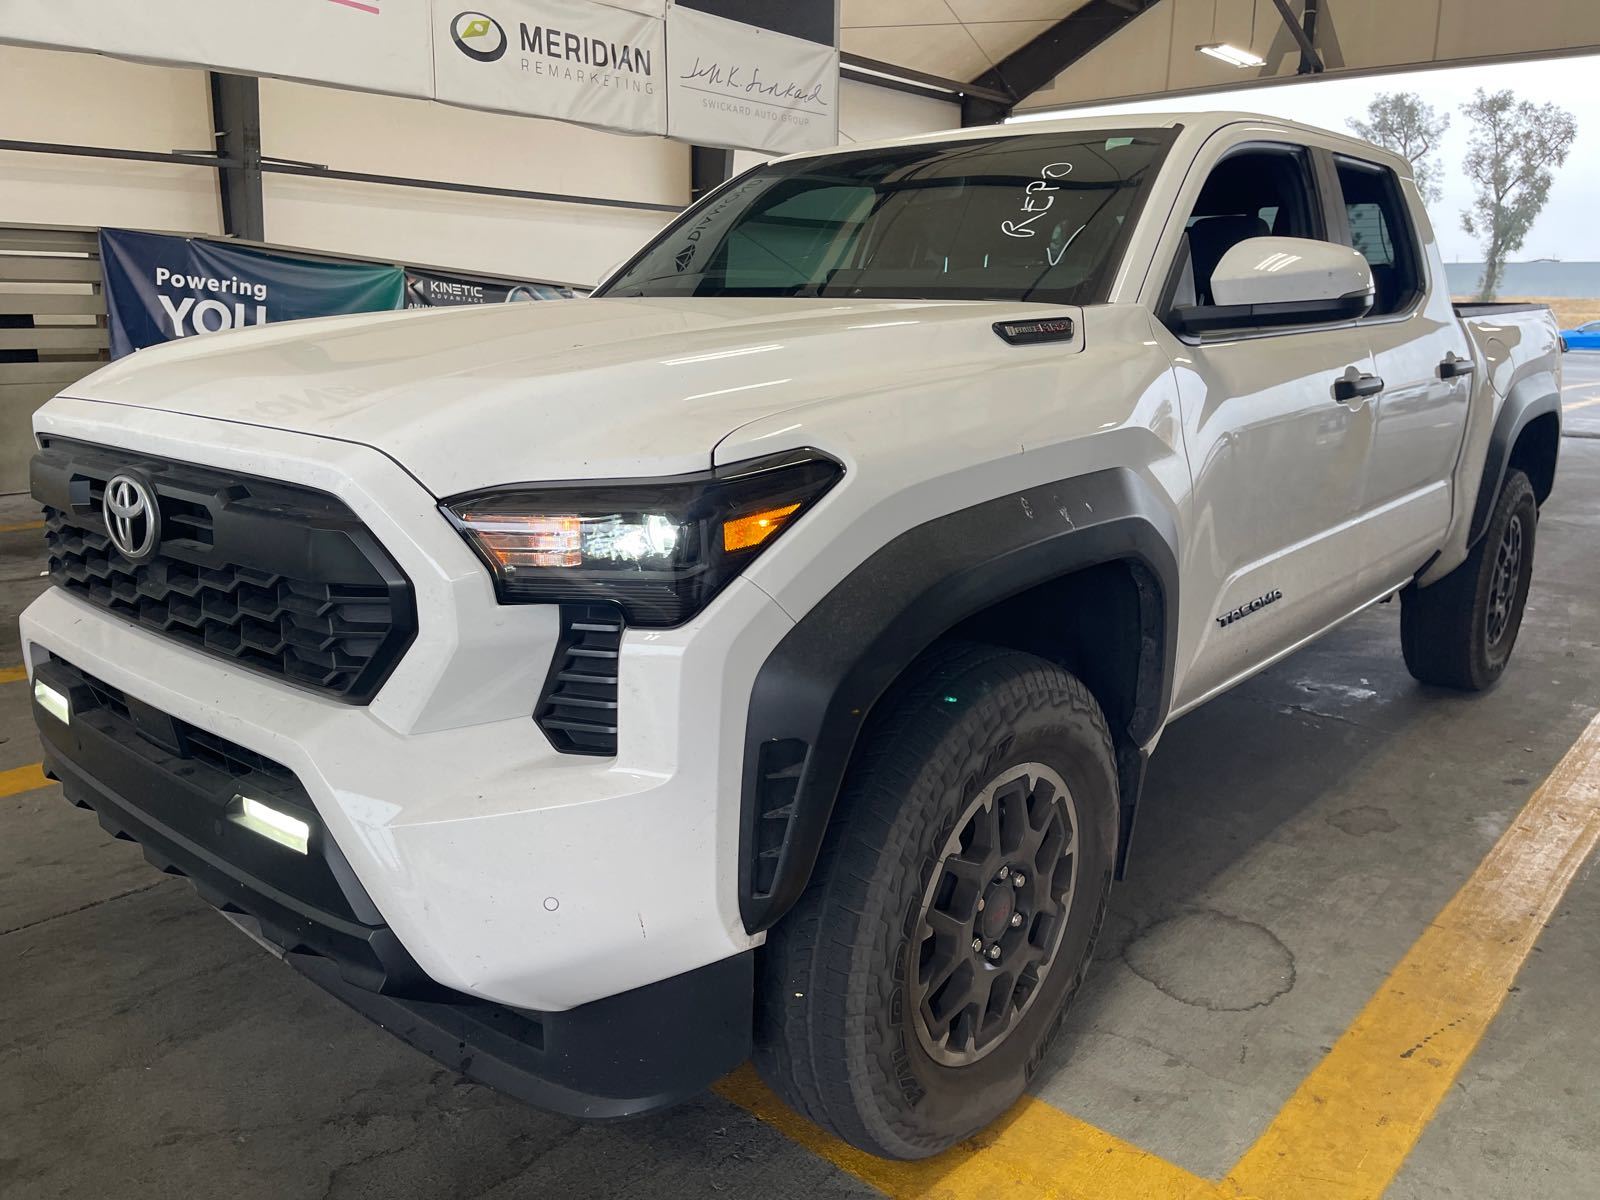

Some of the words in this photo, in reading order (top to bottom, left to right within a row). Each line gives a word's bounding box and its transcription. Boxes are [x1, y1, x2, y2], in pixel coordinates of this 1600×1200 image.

[519, 22, 651, 76] MERIDIAN
[521, 58, 654, 95] REMARKETING
[702, 98, 751, 116] SWICKARD
[754, 109, 778, 121] AUTO
[780, 114, 810, 127] GROUP
[1001, 162, 1073, 238] REPO
[156, 267, 267, 301] Powering
[430, 281, 483, 297] KINETIC
[431, 293, 484, 304] ADVANTAGE
[157, 295, 267, 337] YOU
[1215, 588, 1283, 628] TACOMA
